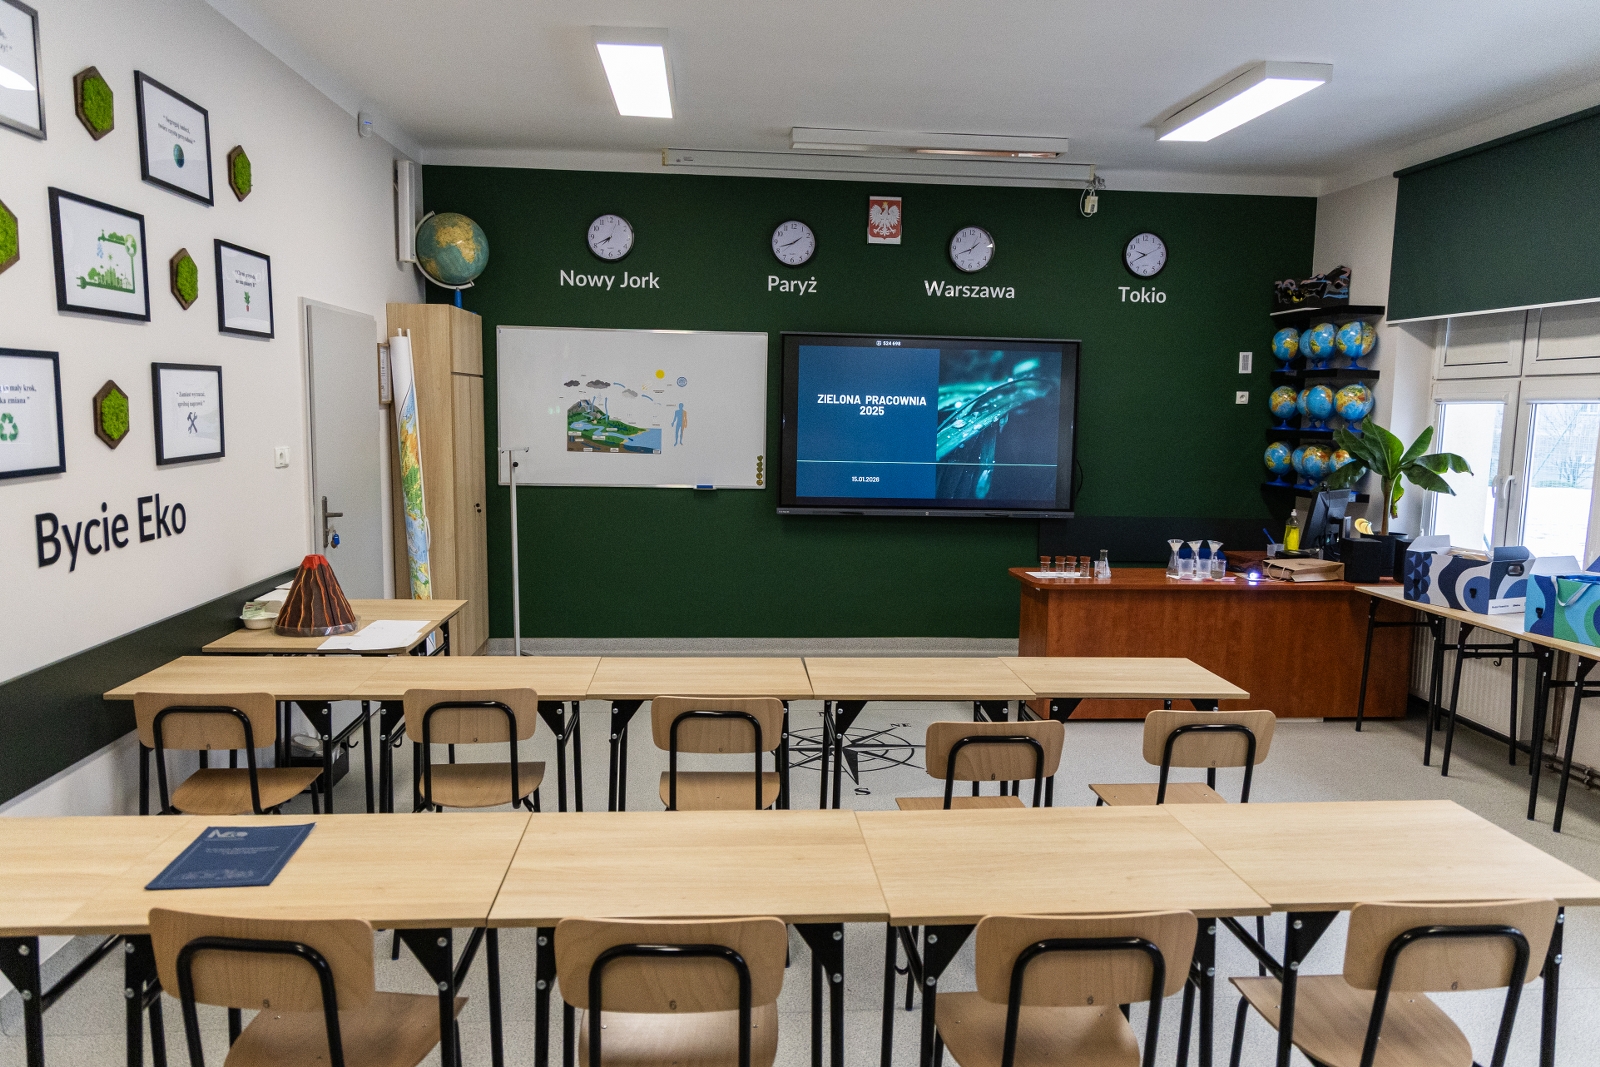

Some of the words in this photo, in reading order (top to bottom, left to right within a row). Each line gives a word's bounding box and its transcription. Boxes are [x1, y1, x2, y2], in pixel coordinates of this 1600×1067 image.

[560, 269, 615, 291] Nowy
[620, 271, 660, 289] Jork
[768, 275, 818, 296] Paryż
[924, 280, 1015, 299] Warszawa
[1117, 286, 1167, 304] Tokio
[817, 394, 861, 404] ZIELONA
[865, 395, 927, 406] PRACOWNIA
[859, 406, 885, 416] 2025
[35, 502, 129, 573] Bycie
[137, 493, 187, 543] Eko
[854, 788, 871, 796] S
